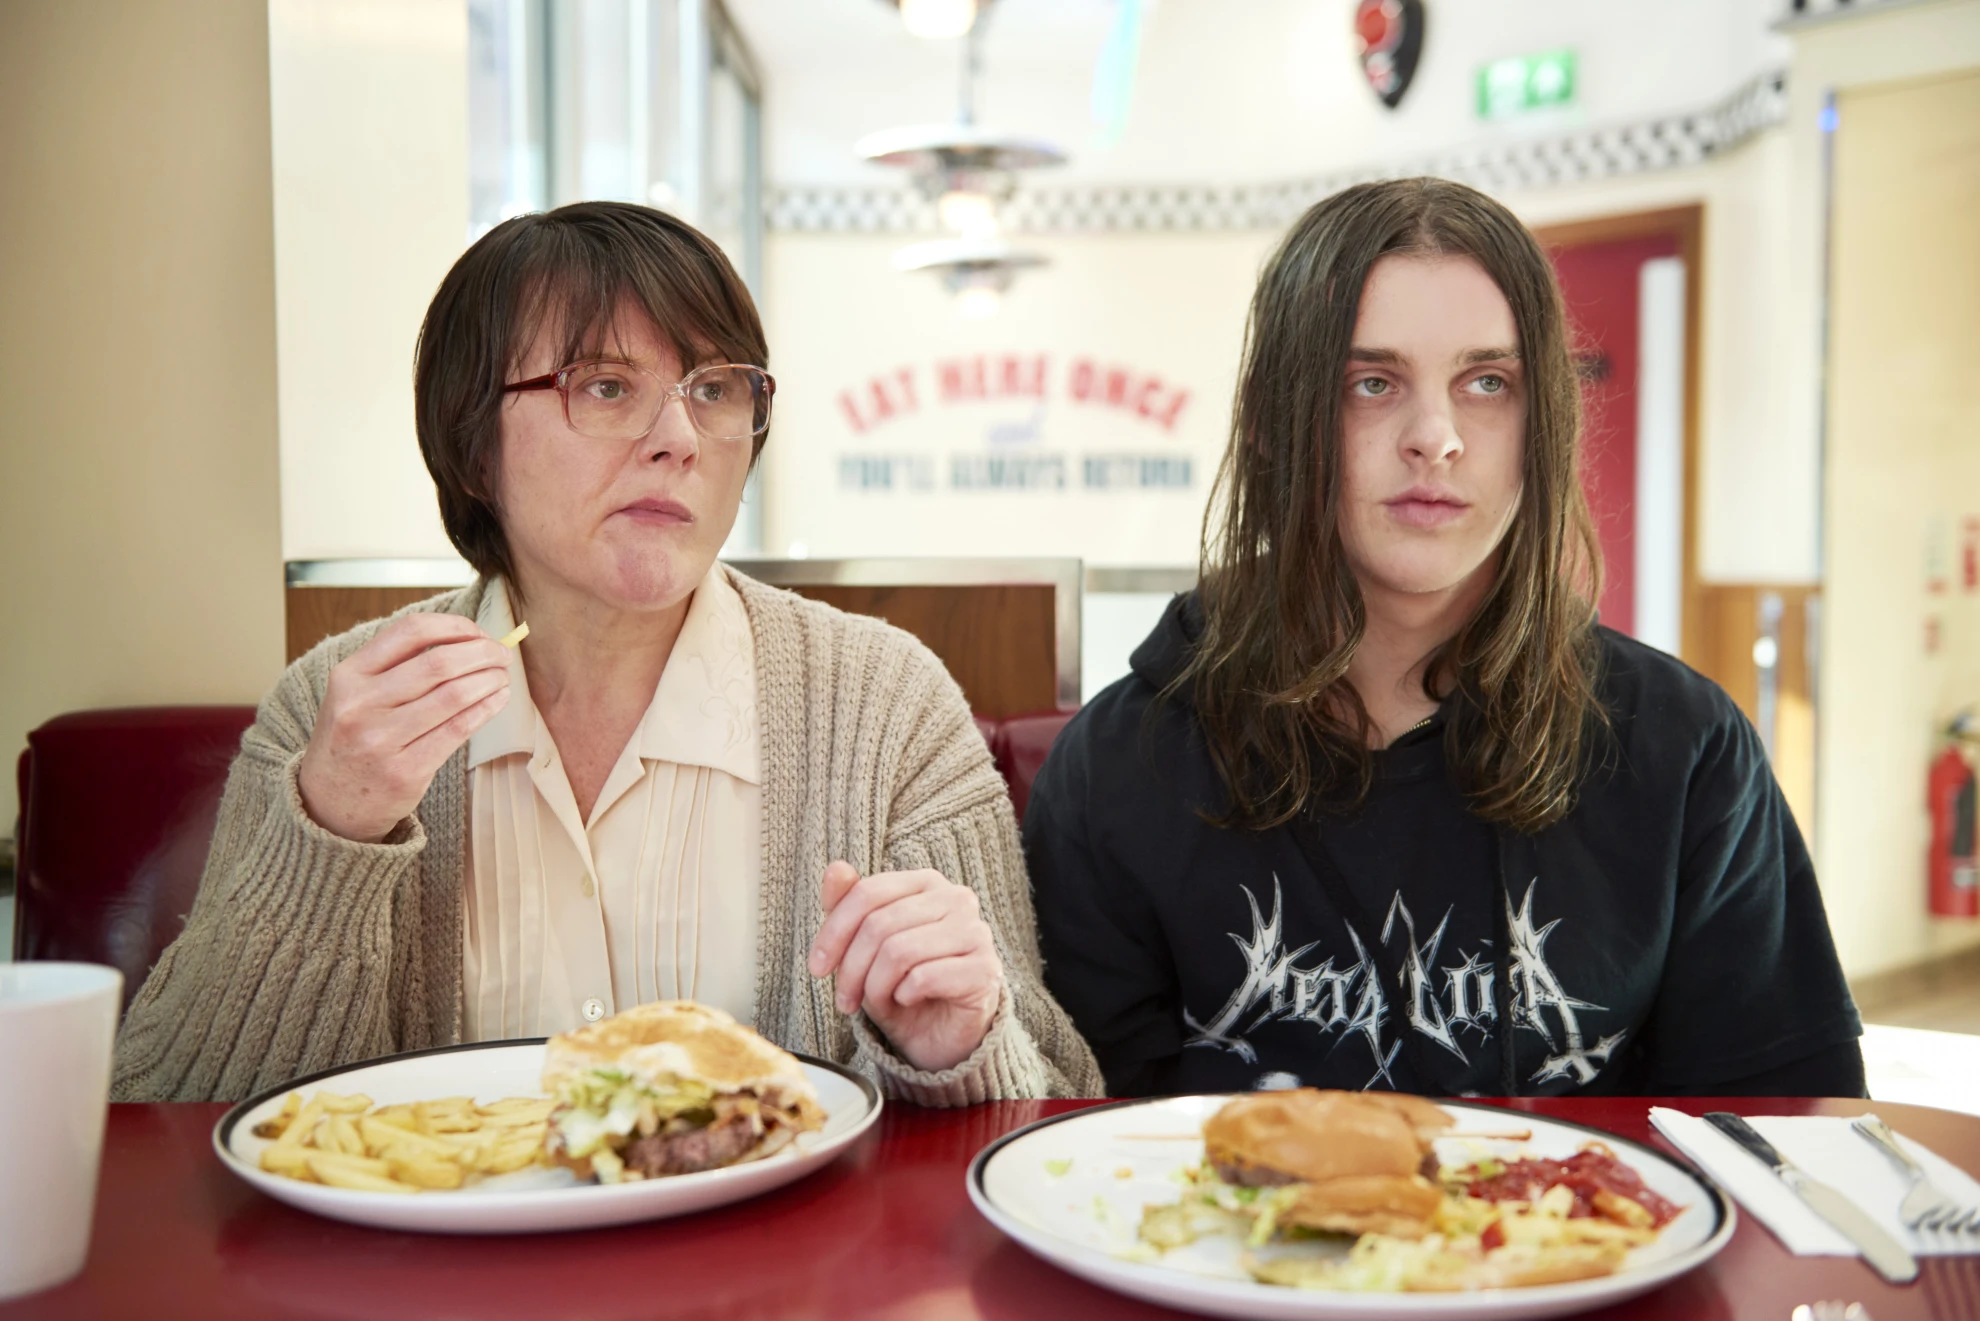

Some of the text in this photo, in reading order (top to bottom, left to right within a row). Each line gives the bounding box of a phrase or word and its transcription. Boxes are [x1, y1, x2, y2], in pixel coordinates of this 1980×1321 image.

[837, 352, 1192, 434] EAT HERE ONCE
[950, 452, 1066, 491] ALWAYS
[1083, 453, 1194, 490] RETURN
